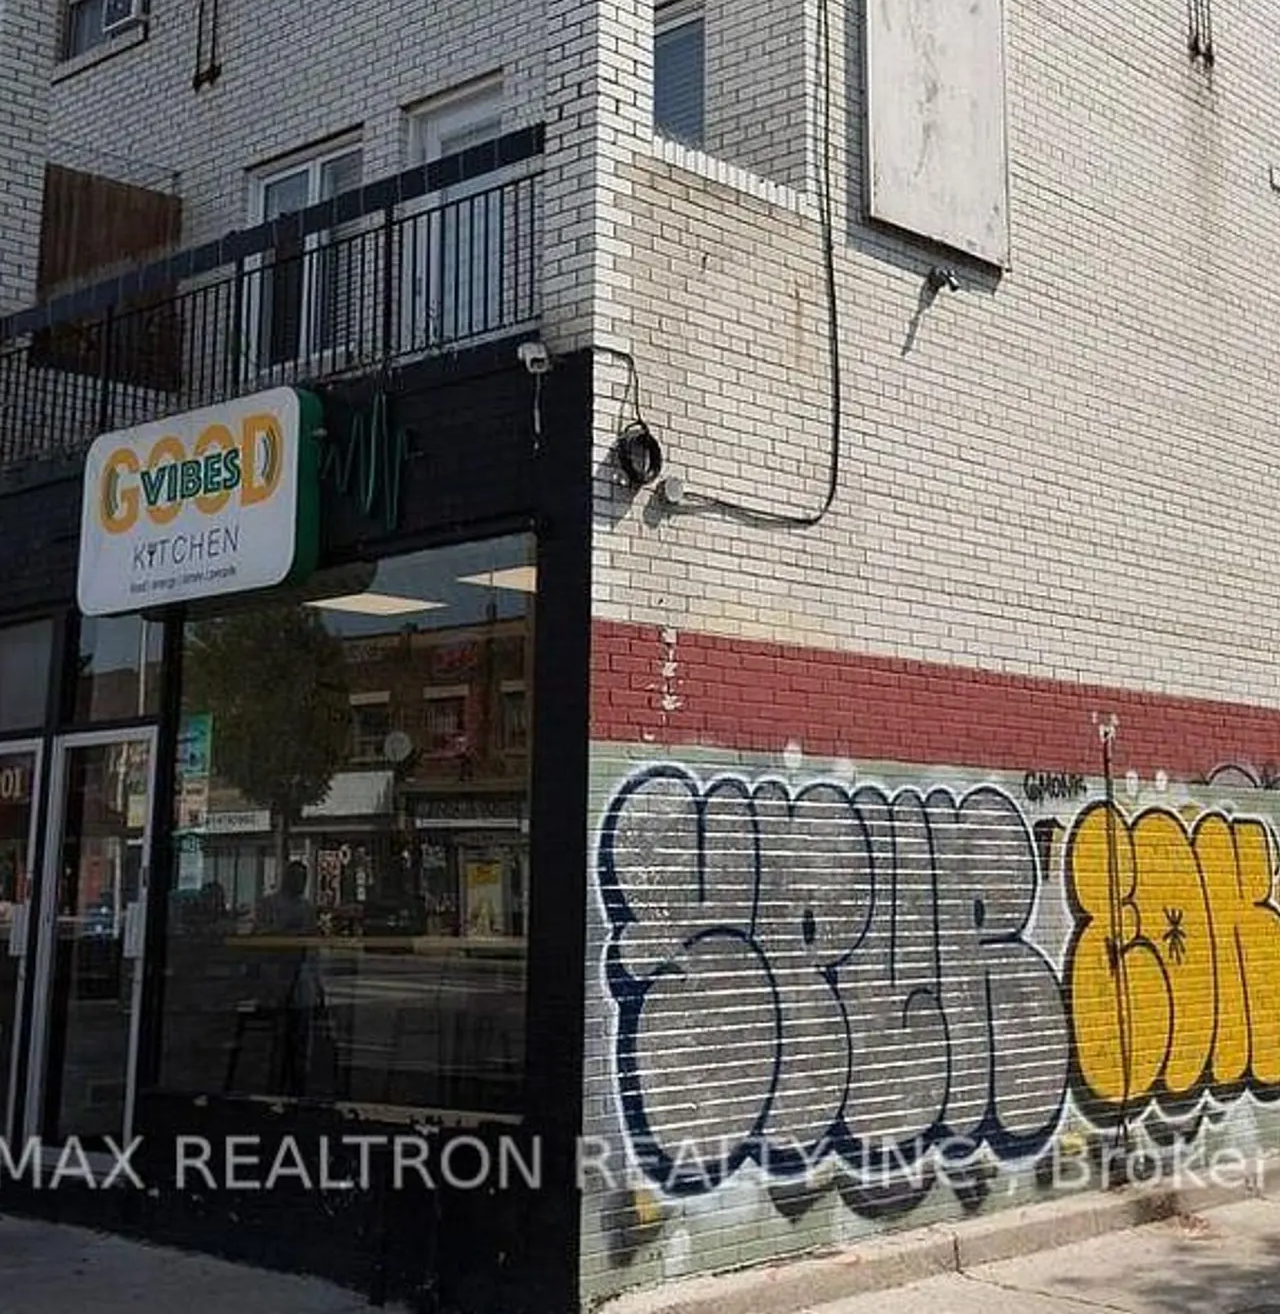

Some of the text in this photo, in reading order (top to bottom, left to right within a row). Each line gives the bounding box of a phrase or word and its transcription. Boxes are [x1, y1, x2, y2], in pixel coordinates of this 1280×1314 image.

[99, 412, 283, 534] GOOD
[140, 448, 241, 507] VIBES
[132, 525, 241, 571] KITCHEN
